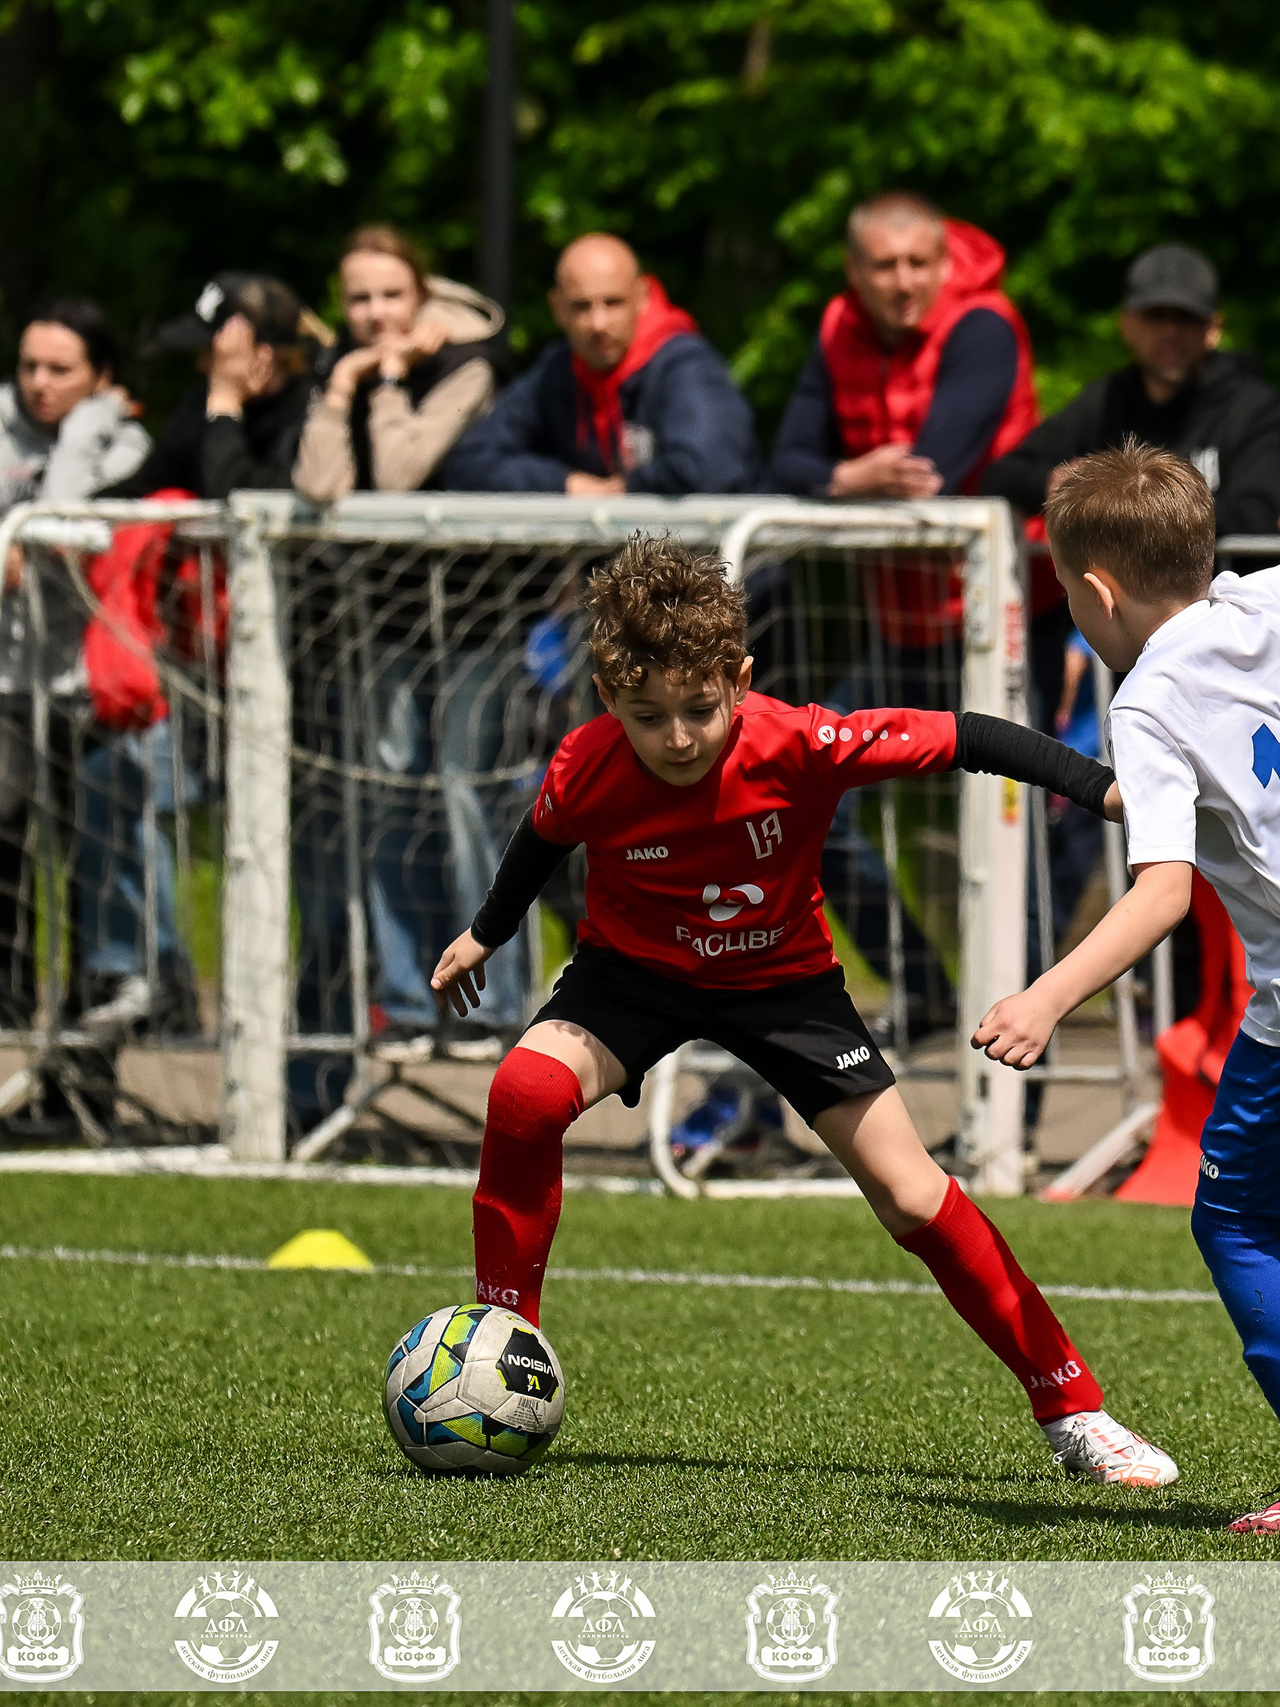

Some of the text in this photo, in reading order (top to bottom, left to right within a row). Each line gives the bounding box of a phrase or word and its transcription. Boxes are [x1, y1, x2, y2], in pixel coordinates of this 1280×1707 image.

[626, 846, 669, 860] JAKO
[676, 921, 790, 957] РАСЦВЕ
[835, 1045, 871, 1070] JAKO
[476, 1280, 519, 1305] AKO
[507, 1354, 555, 1377] VISION
[1030, 1360, 1082, 1389] JAKO
